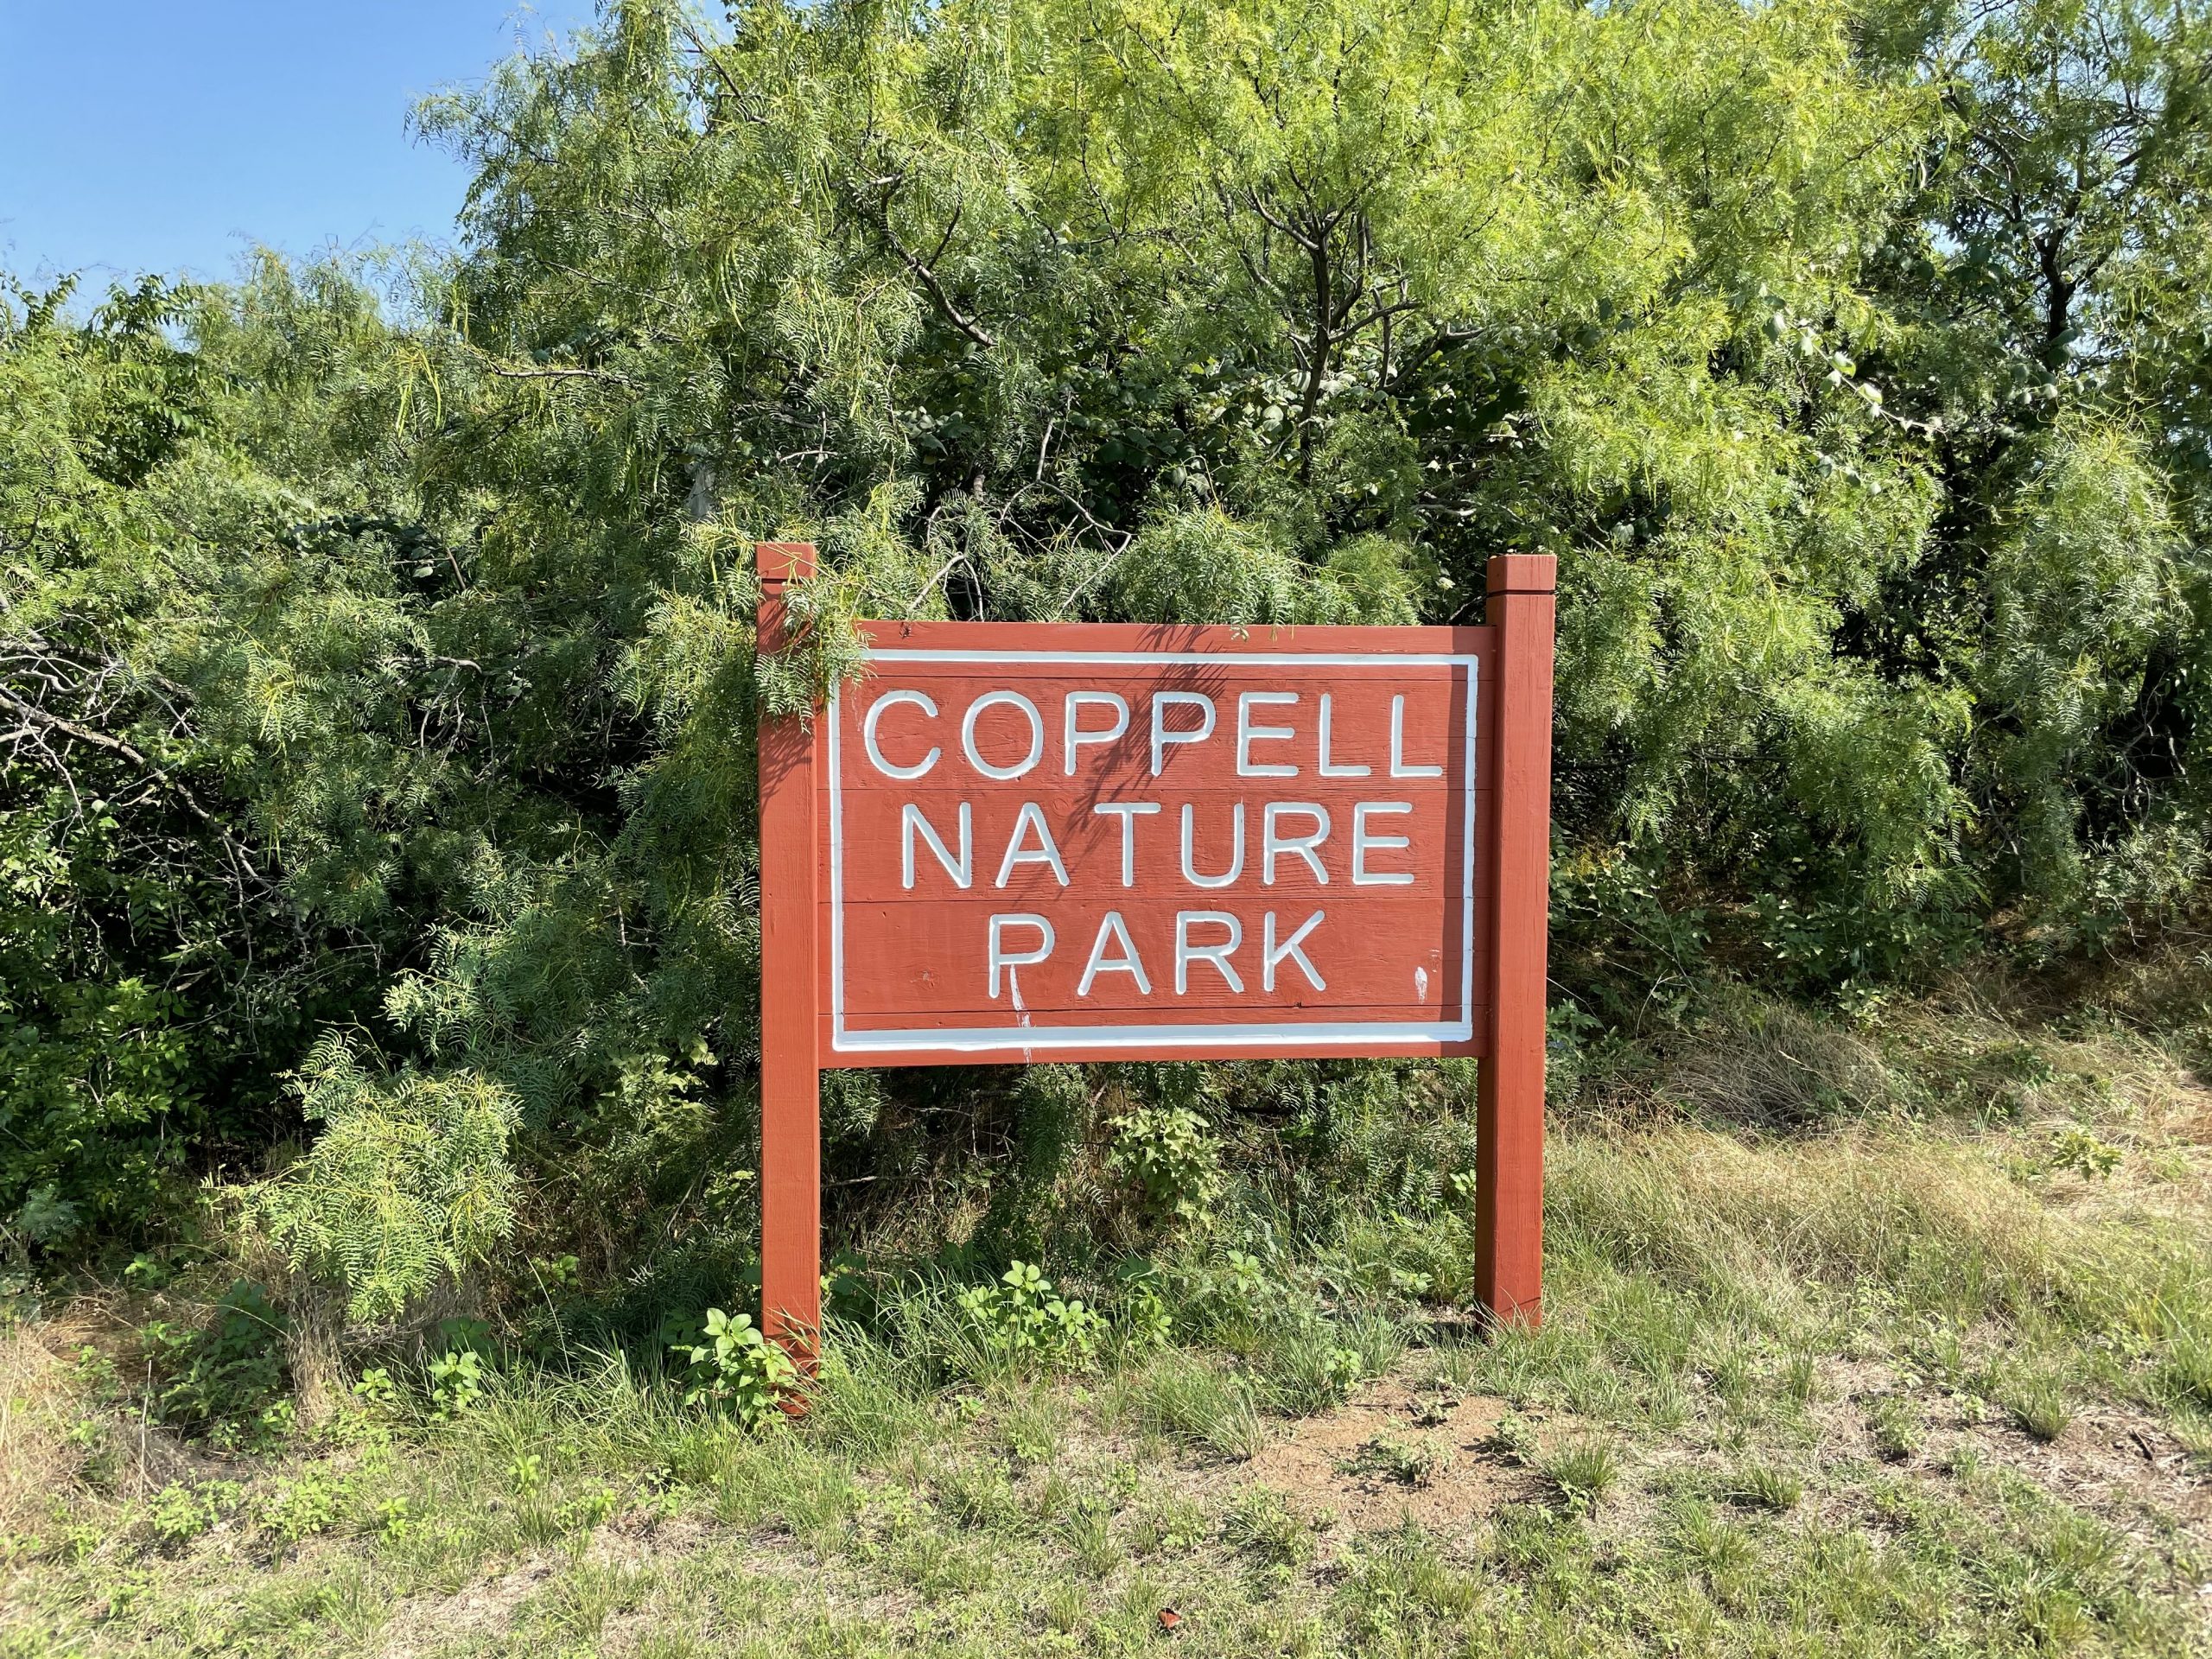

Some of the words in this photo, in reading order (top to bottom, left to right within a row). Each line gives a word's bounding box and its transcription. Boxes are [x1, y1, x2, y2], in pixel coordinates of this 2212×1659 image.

[863, 690, 1444, 781] COPPELL
[902, 801, 1414, 889] NATURE
[988, 910, 1327, 997] PARK
